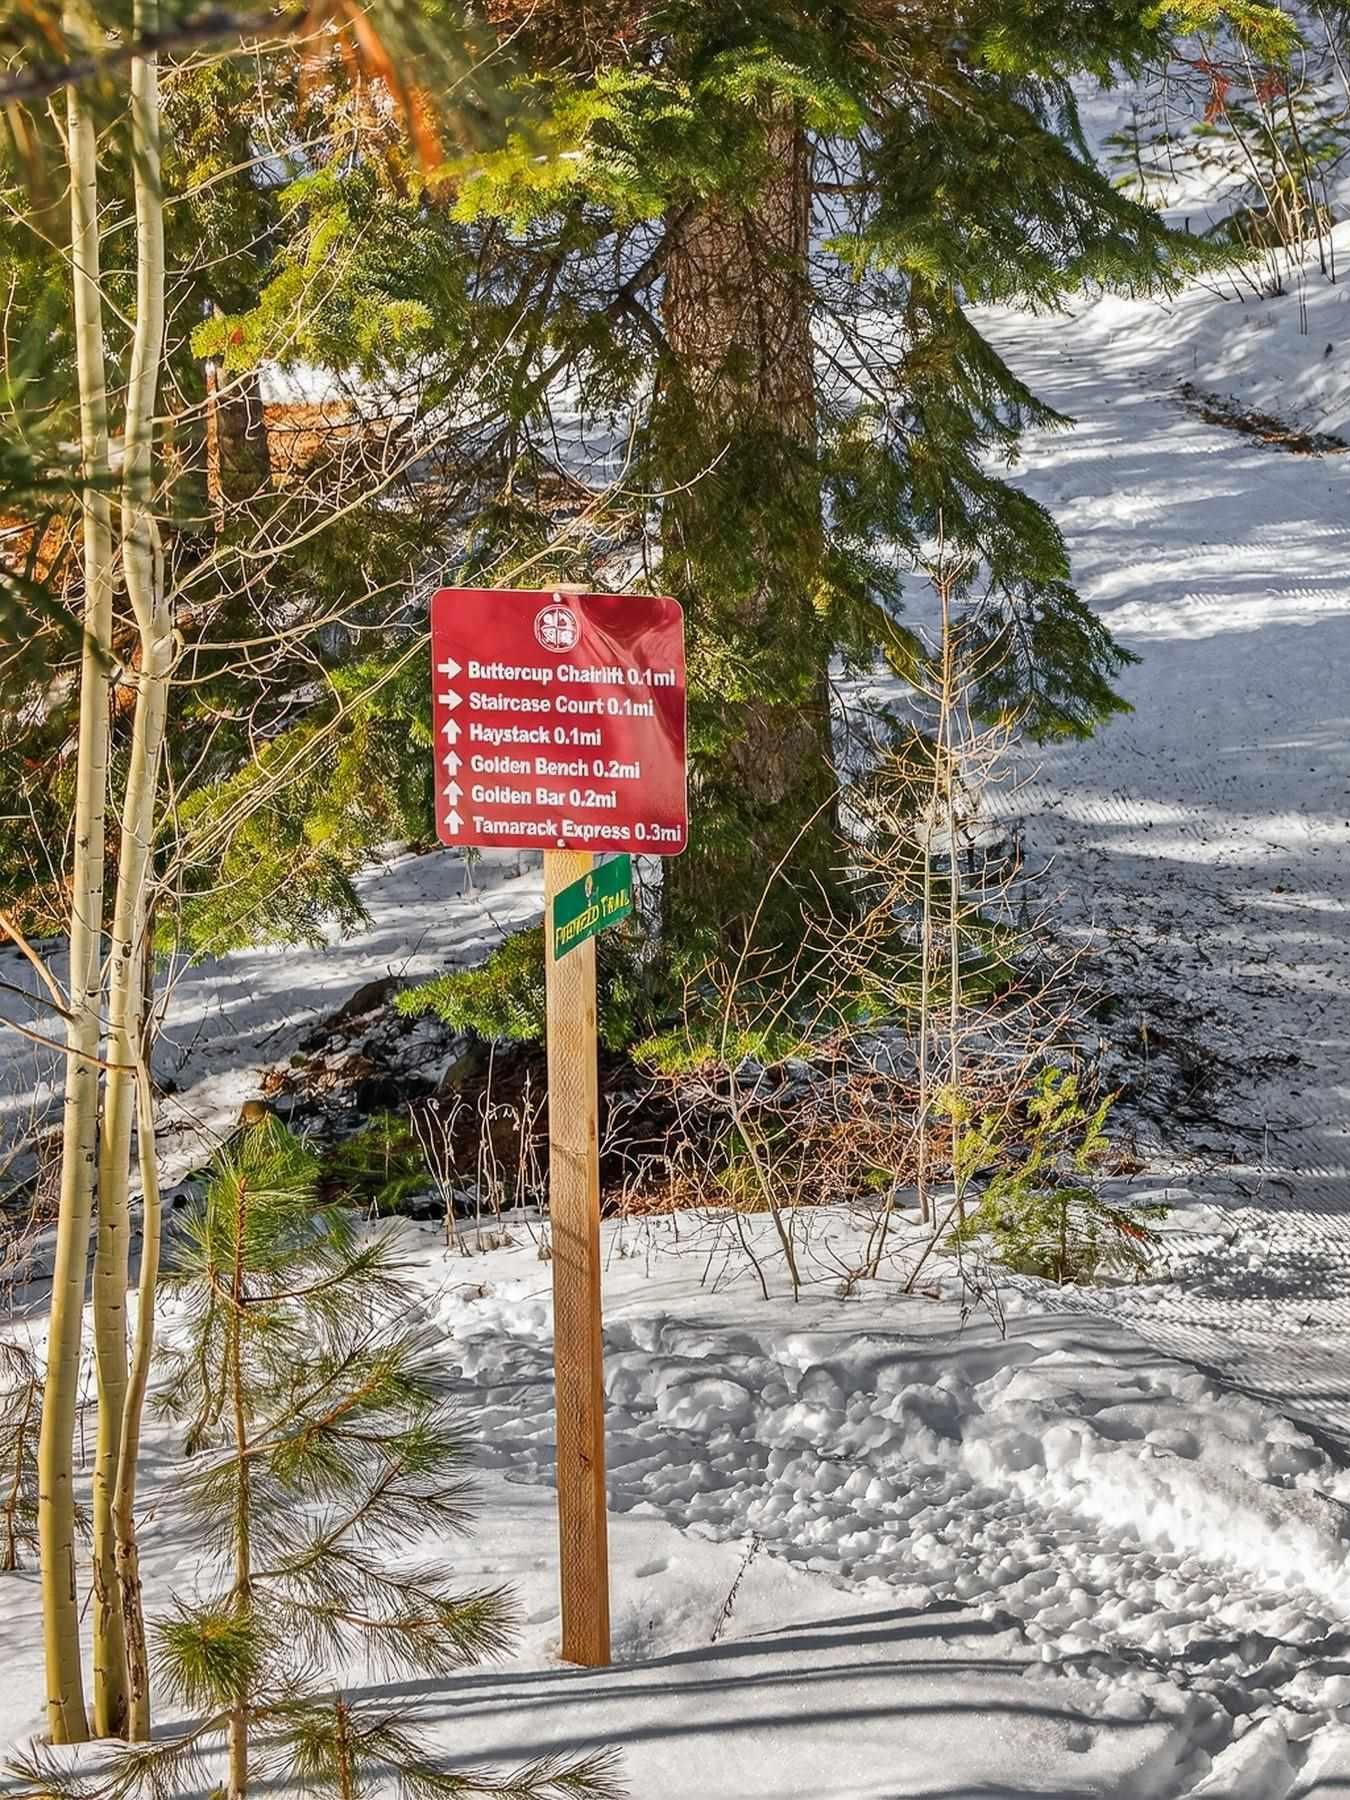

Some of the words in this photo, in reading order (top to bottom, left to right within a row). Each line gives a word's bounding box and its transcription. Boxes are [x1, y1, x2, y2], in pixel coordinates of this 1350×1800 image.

[468, 660, 553, 685] Buttercup
[557, 664, 624, 685] Chairlift
[628, 668, 676, 686] 0.1mi
[469, 692, 550, 713] Staircase
[555, 696, 604, 715] Court
[607, 698, 654, 717] 0.1mi
[469, 723, 550, 746] Haystack
[554, 727, 602, 746] 0.1mi
[470, 755, 531, 774] Golden
[535, 757, 589, 777] Bench
[593, 760, 641, 779] 0.2mi
[471, 784, 532, 805] Golden
[535, 787, 565, 806] Bar
[569, 789, 617, 808] 0.2mi
[472, 816, 558, 837] Tamarack
[562, 819, 631, 842] Express
[635, 822, 682, 842] 0.3mi
